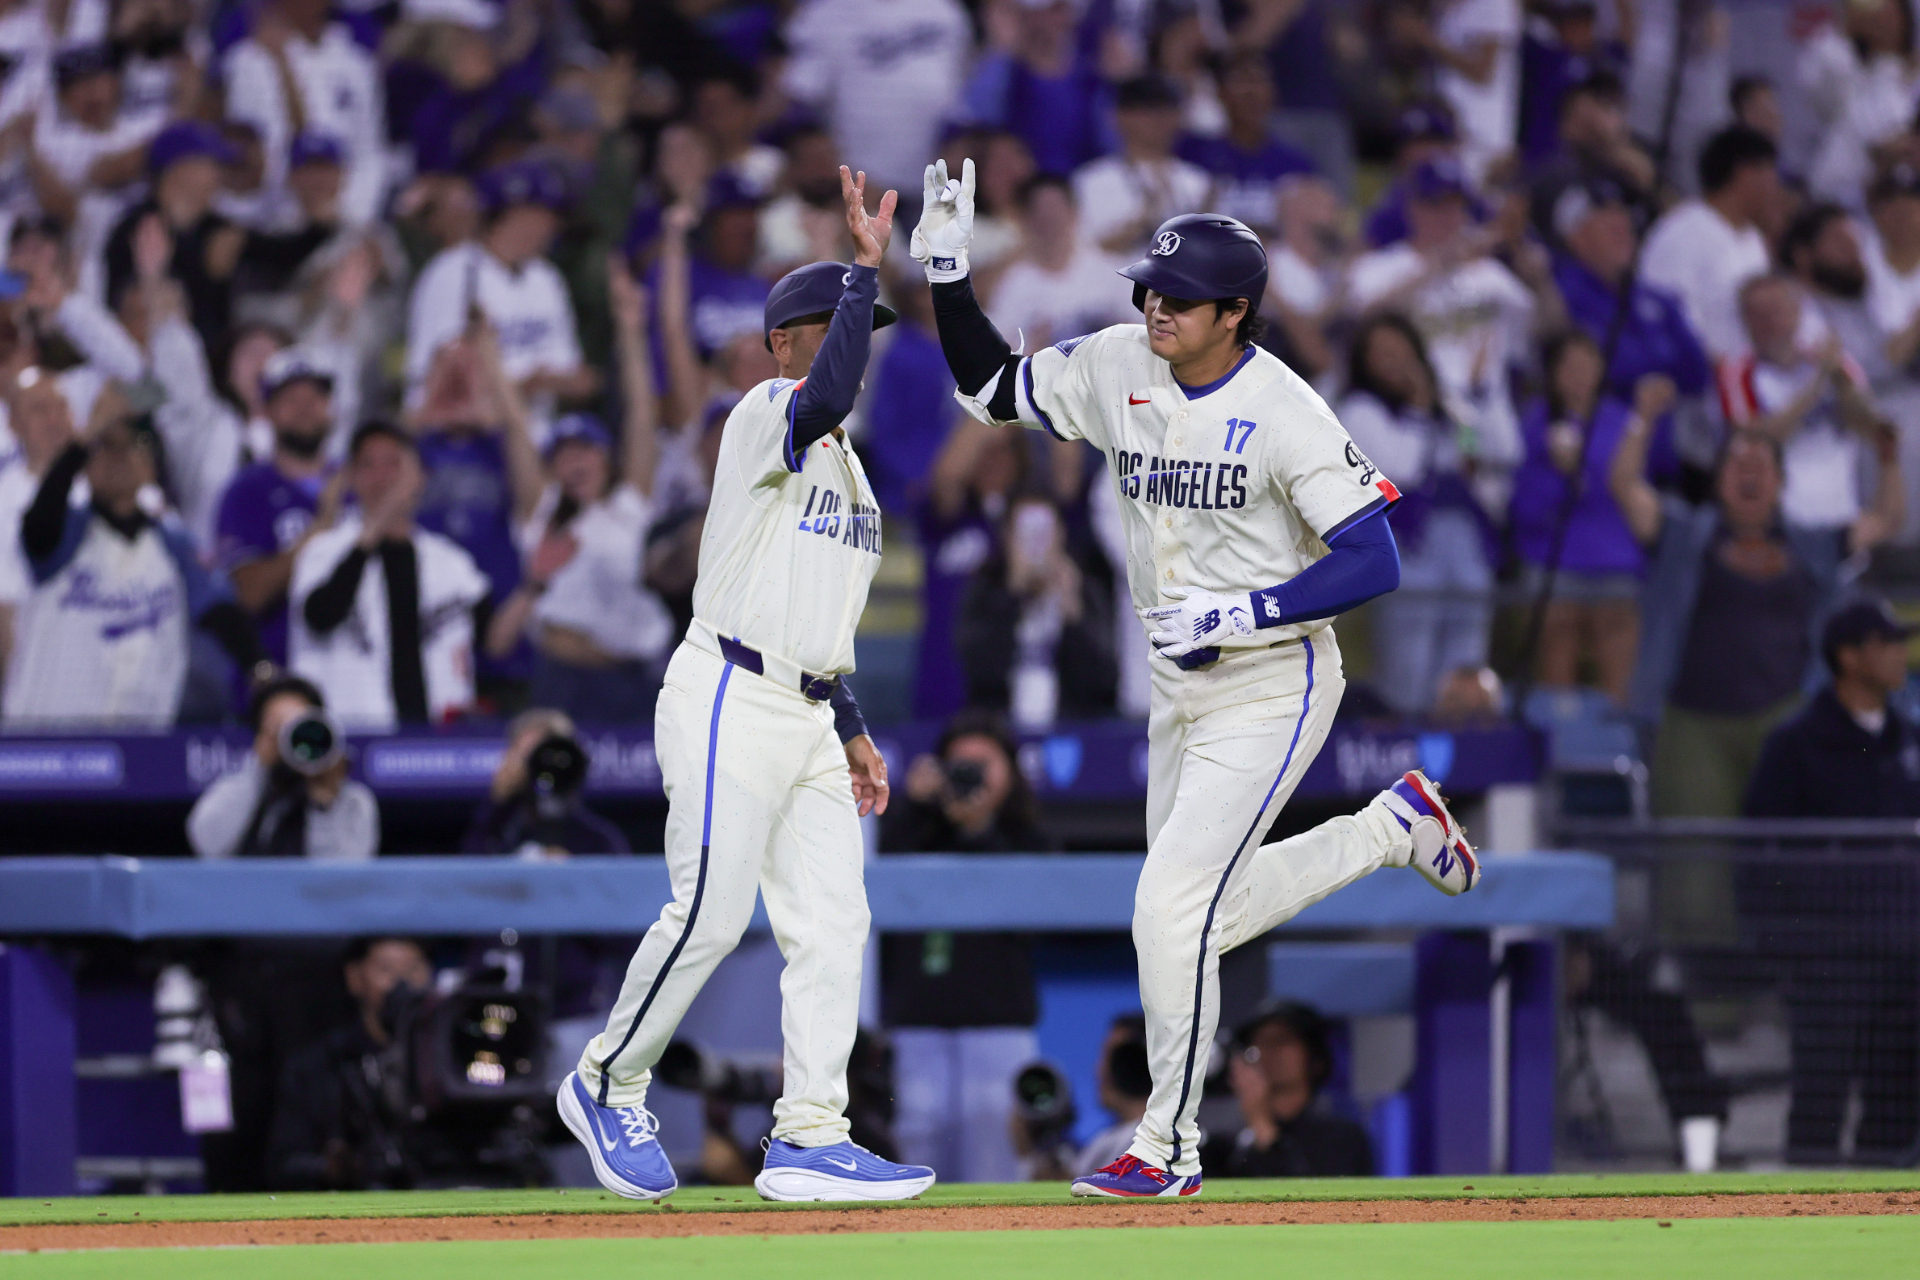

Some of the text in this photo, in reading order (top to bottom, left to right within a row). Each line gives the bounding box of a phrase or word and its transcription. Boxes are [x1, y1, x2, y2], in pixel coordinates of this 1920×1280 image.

[1224, 417, 1257, 454] 17
[1112, 446, 1248, 510] OS ANGELES
[798, 485, 841, 539] LOS
